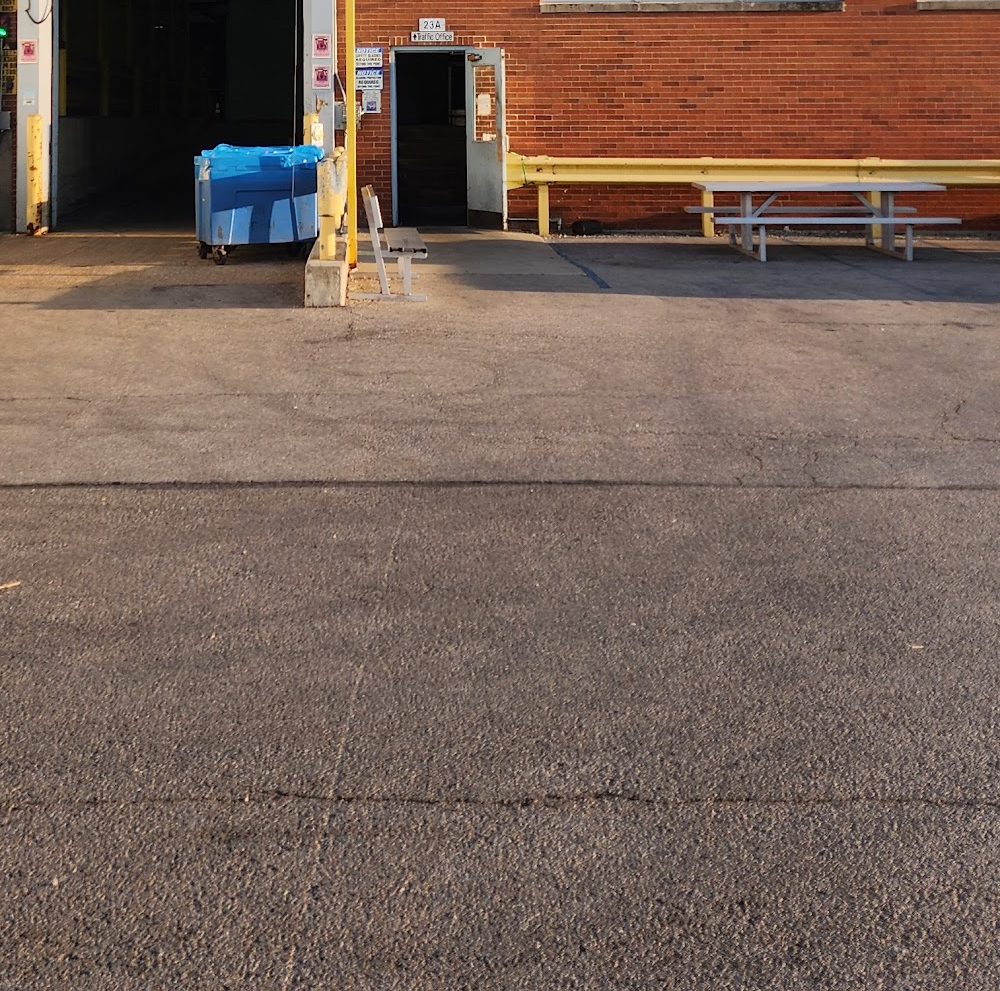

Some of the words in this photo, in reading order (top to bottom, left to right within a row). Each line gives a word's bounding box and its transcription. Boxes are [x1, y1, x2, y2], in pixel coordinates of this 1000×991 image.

[423, 20, 441, 30] 23A
[417, 32, 434, 40] Traffic
[434, 32, 453, 40] Office
